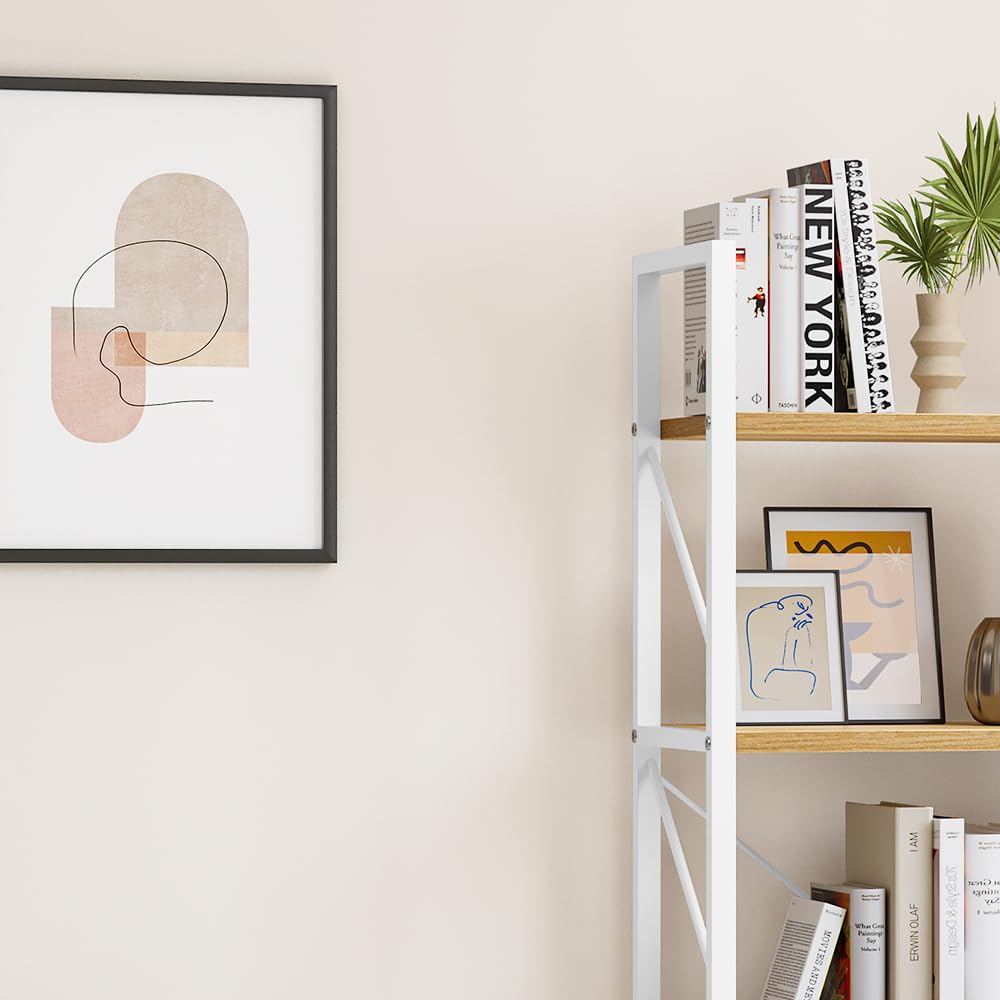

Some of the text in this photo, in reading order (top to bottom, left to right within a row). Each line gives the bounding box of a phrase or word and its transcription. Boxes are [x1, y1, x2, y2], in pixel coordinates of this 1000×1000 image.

[804, 188, 834, 408] NEW YORK
[910, 832, 918, 848] AM
[814, 930, 832, 966] MOVIES
[910, 904, 919, 962] ERWIN OLAF
[808, 966, 821, 987] AND
